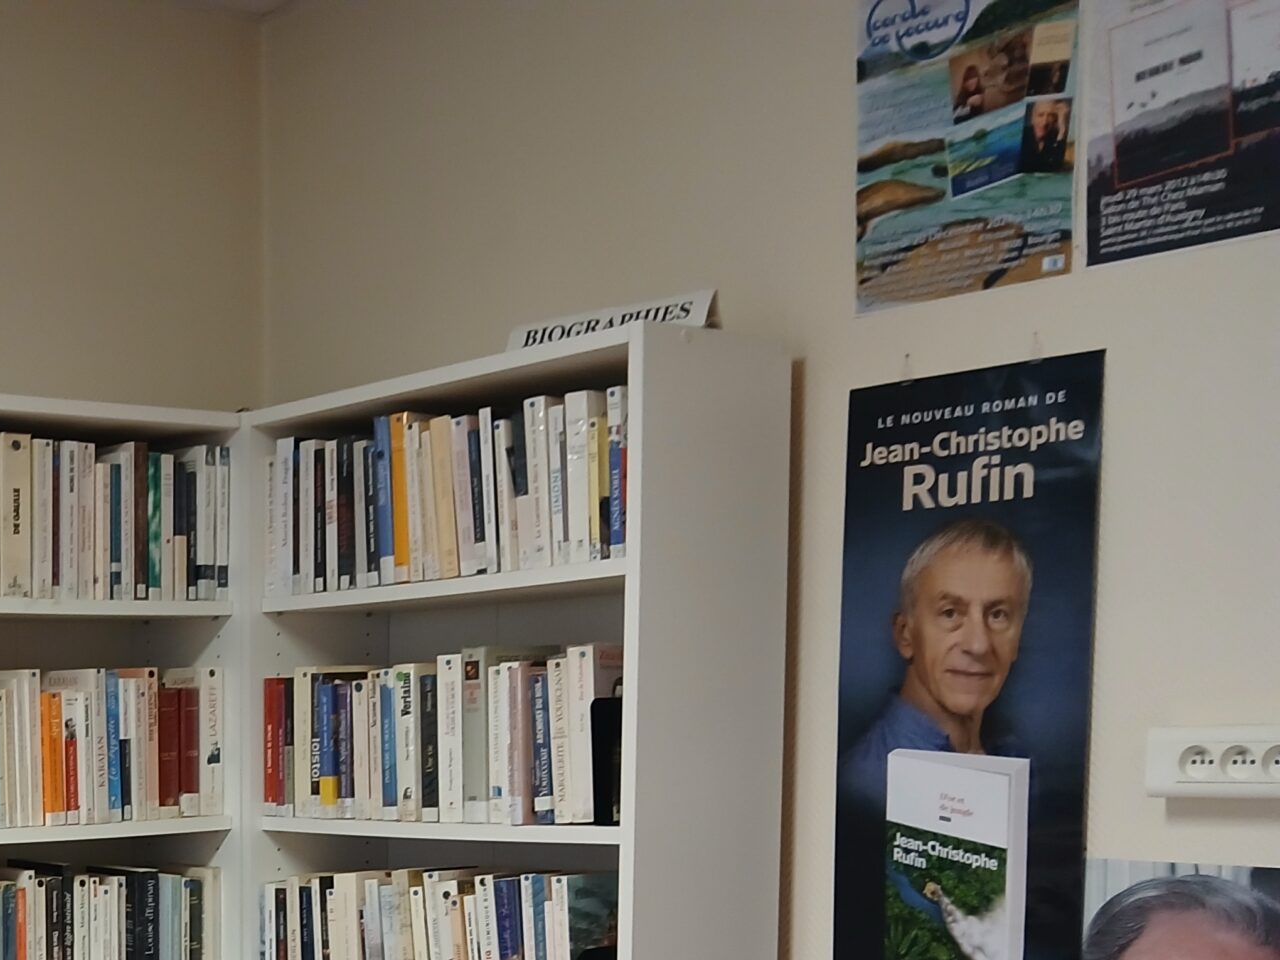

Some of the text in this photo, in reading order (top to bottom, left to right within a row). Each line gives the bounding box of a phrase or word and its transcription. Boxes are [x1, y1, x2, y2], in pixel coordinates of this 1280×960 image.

[521, 301, 693, 349] BIOGRAPHIES
[877, 390, 1067, 429] LE NOUVEAU ROMAN DE
[860, 417, 1085, 467] Jean-Christophe
[902, 455, 1035, 511] Rufin
[13, 523, 20, 535] DE
[400, 671, 412, 717] Verlaine
[97, 736, 106, 787] KARAJAN
[893, 832, 998, 871] Jean-Christophe
[893, 847, 927, 869] Rufin
[144, 921, 154, 954] Louise
